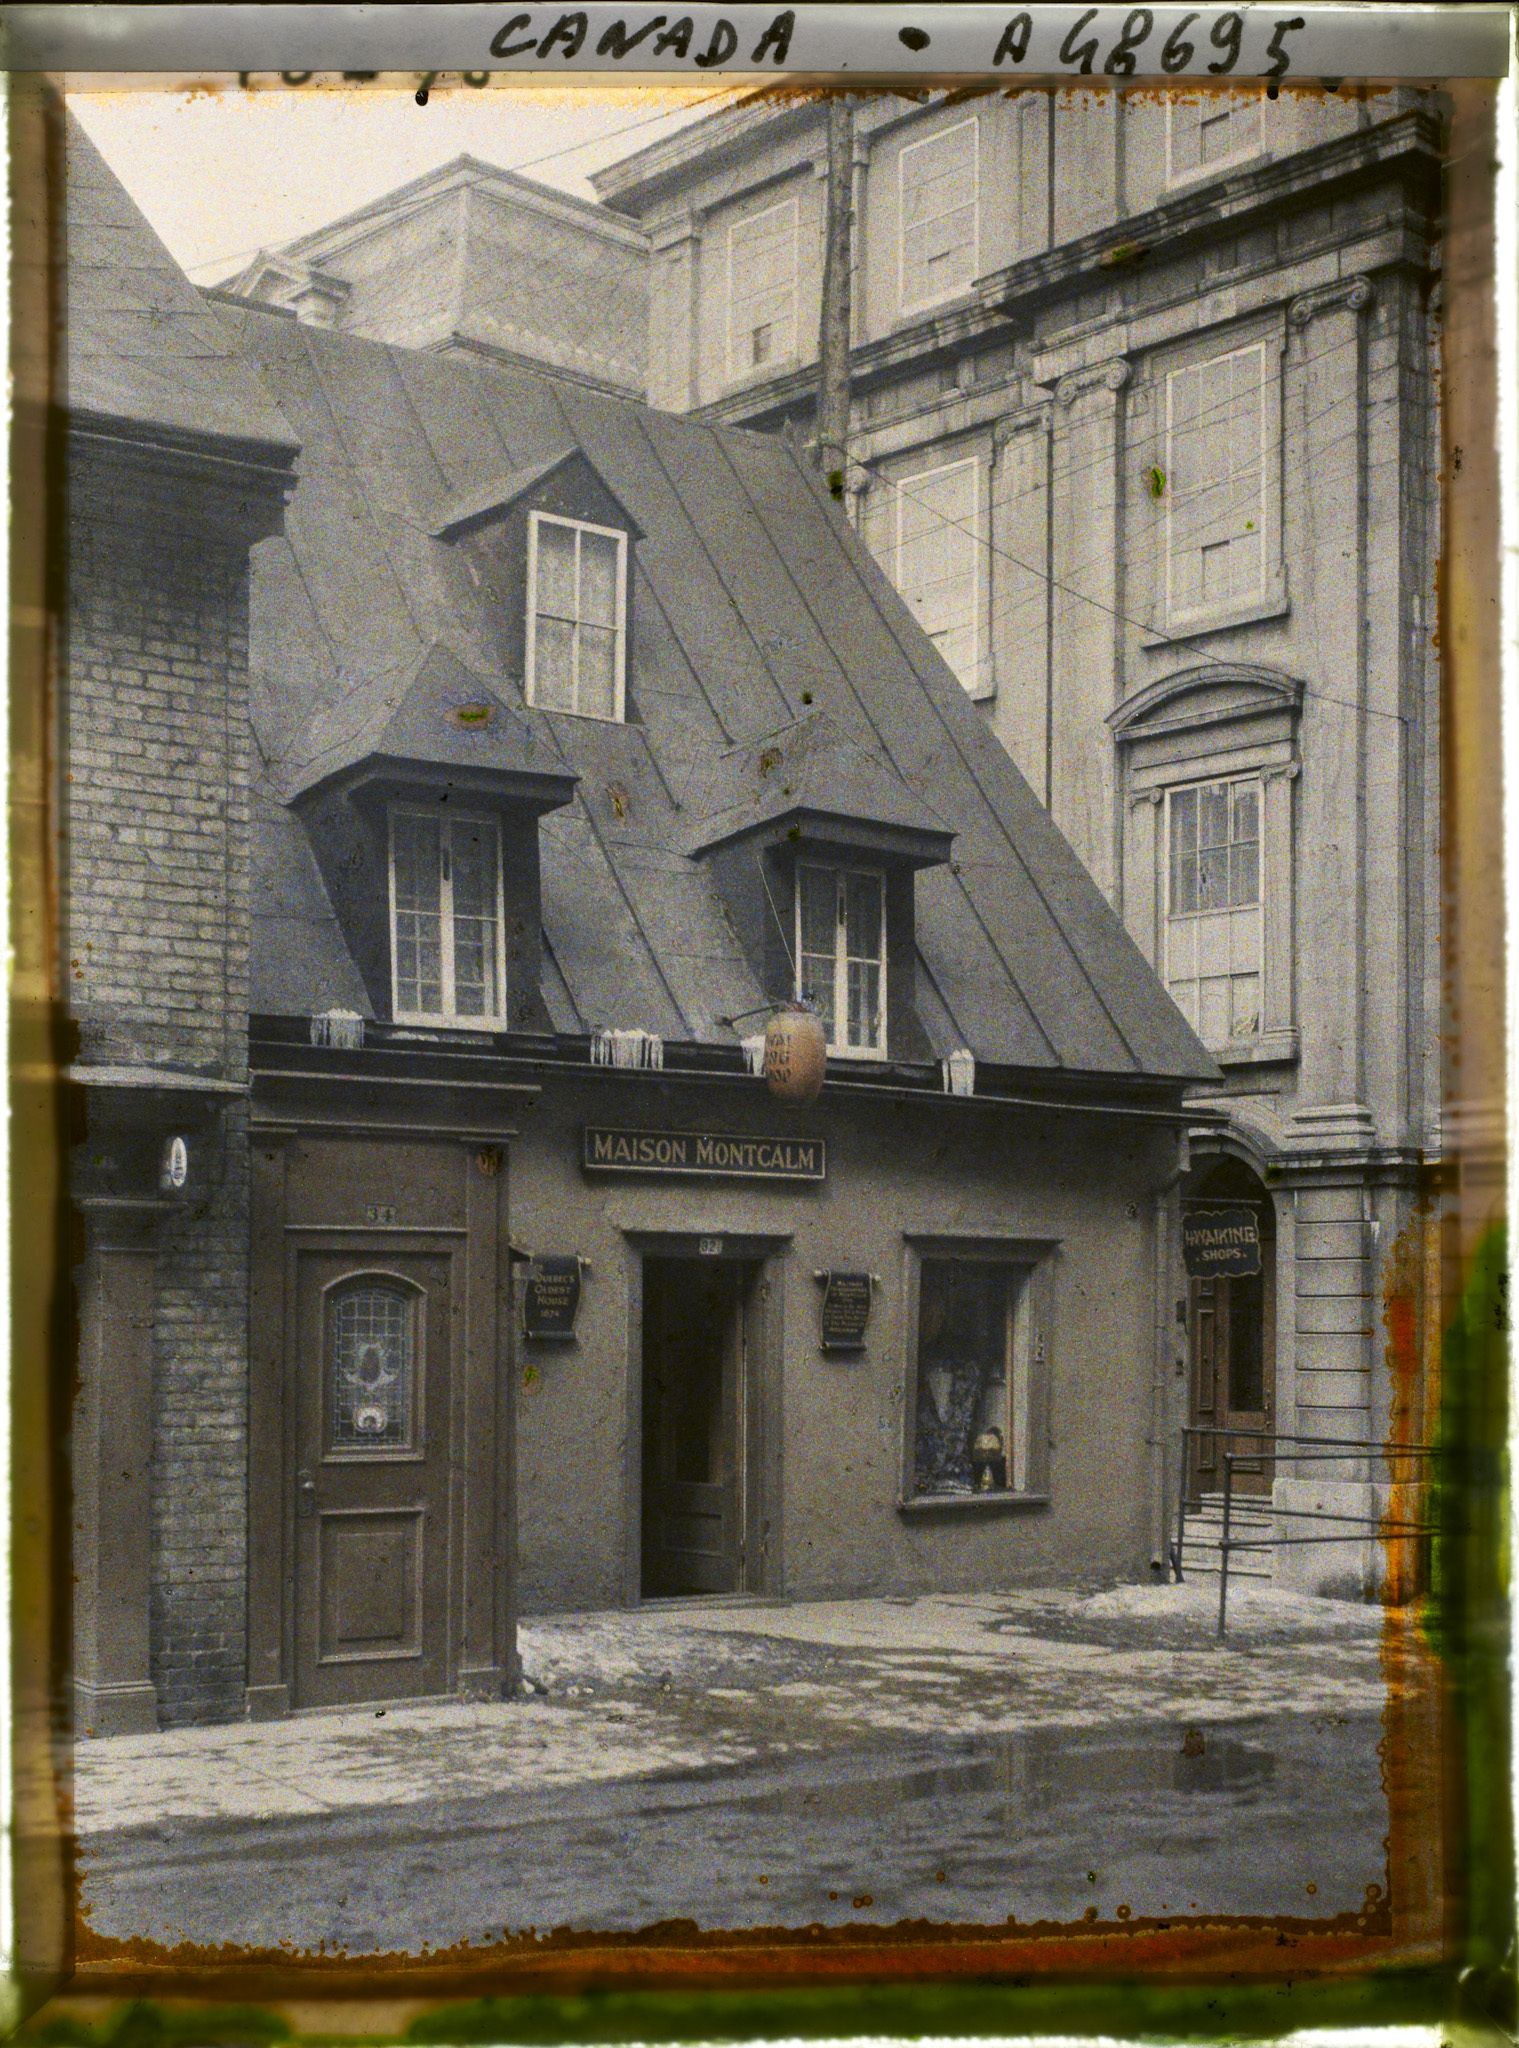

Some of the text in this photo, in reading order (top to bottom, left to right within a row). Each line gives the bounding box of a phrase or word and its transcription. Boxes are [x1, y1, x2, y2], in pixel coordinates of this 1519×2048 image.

[489, 10, 796, 68] CANADA
[594, 1133, 815, 1170] MAISON MONTCALM
